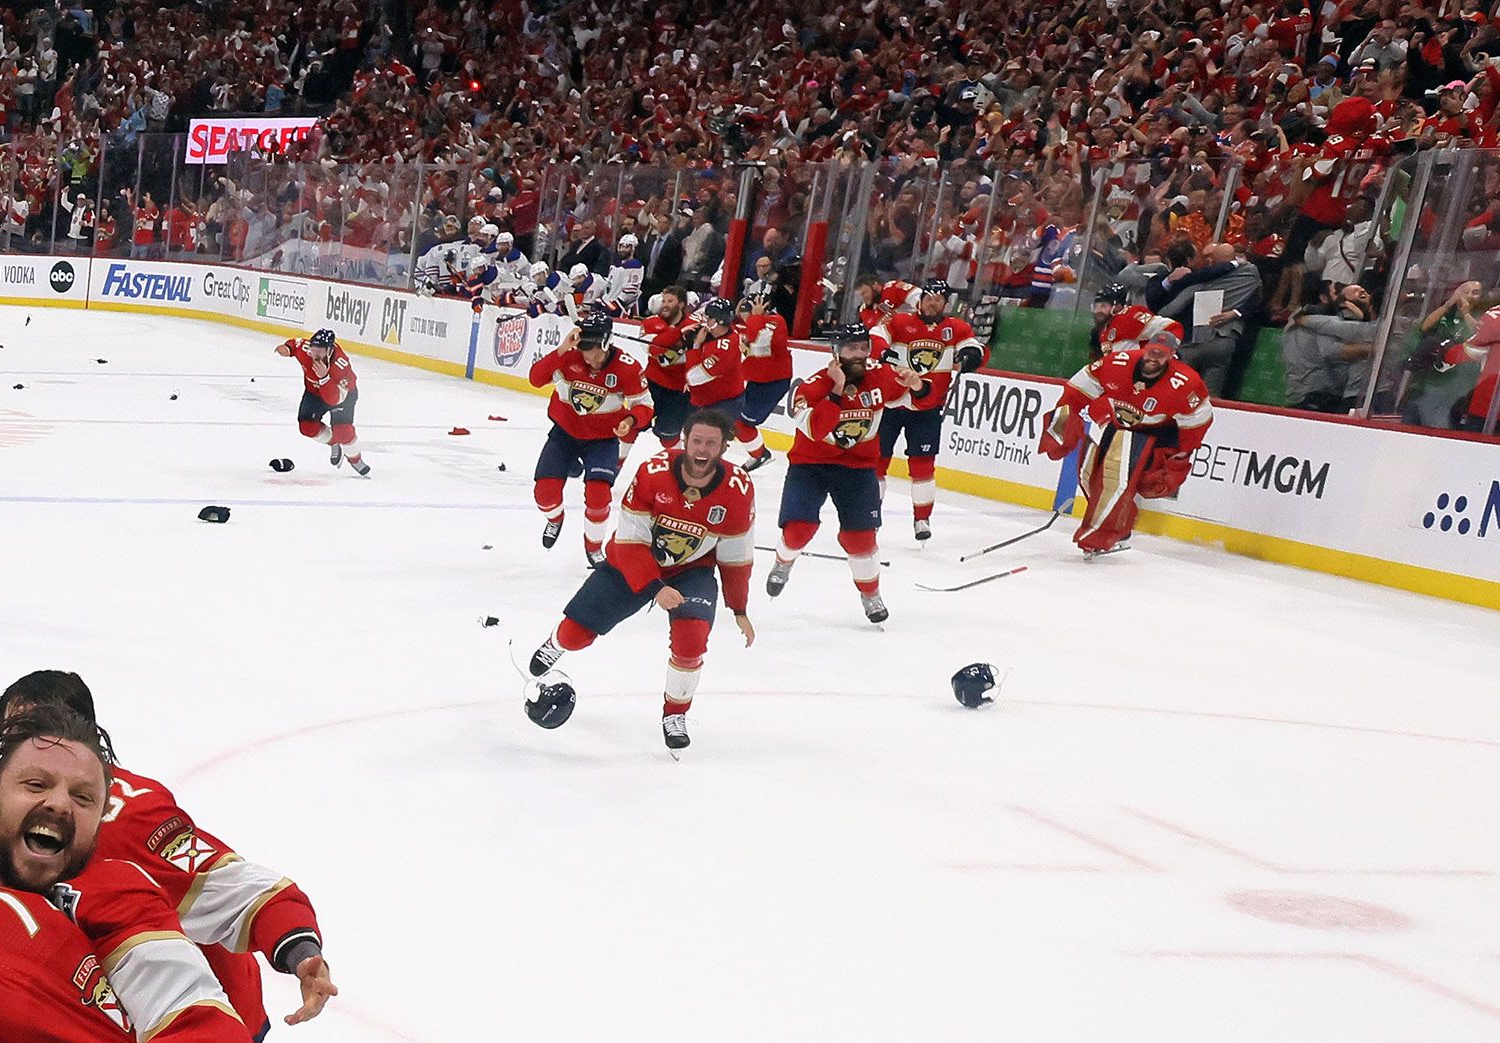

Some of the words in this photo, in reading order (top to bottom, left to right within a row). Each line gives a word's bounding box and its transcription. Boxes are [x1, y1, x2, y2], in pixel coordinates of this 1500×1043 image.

[4, 266, 35, 285] VODKA
[50, 267, 75, 283] abc
[203, 272, 231, 299] Great
[231, 276, 250, 309] Clips
[261, 285, 305, 316] enterprise
[326, 286, 371, 337] betway
[381, 296, 407, 345] CAT
[544, 325, 561, 346] sub
[717, 339, 730, 350] 15
[1112, 351, 1130, 366] 41
[1169, 371, 1189, 390] 41
[872, 389, 882, 405] A
[949, 431, 992, 457] Sports
[994, 444, 1032, 465] Drink
[1191, 443, 1330, 499] BETMGM
[660, 517, 703, 536] PANTHERS
[150, 819, 179, 846] FLORIDA
